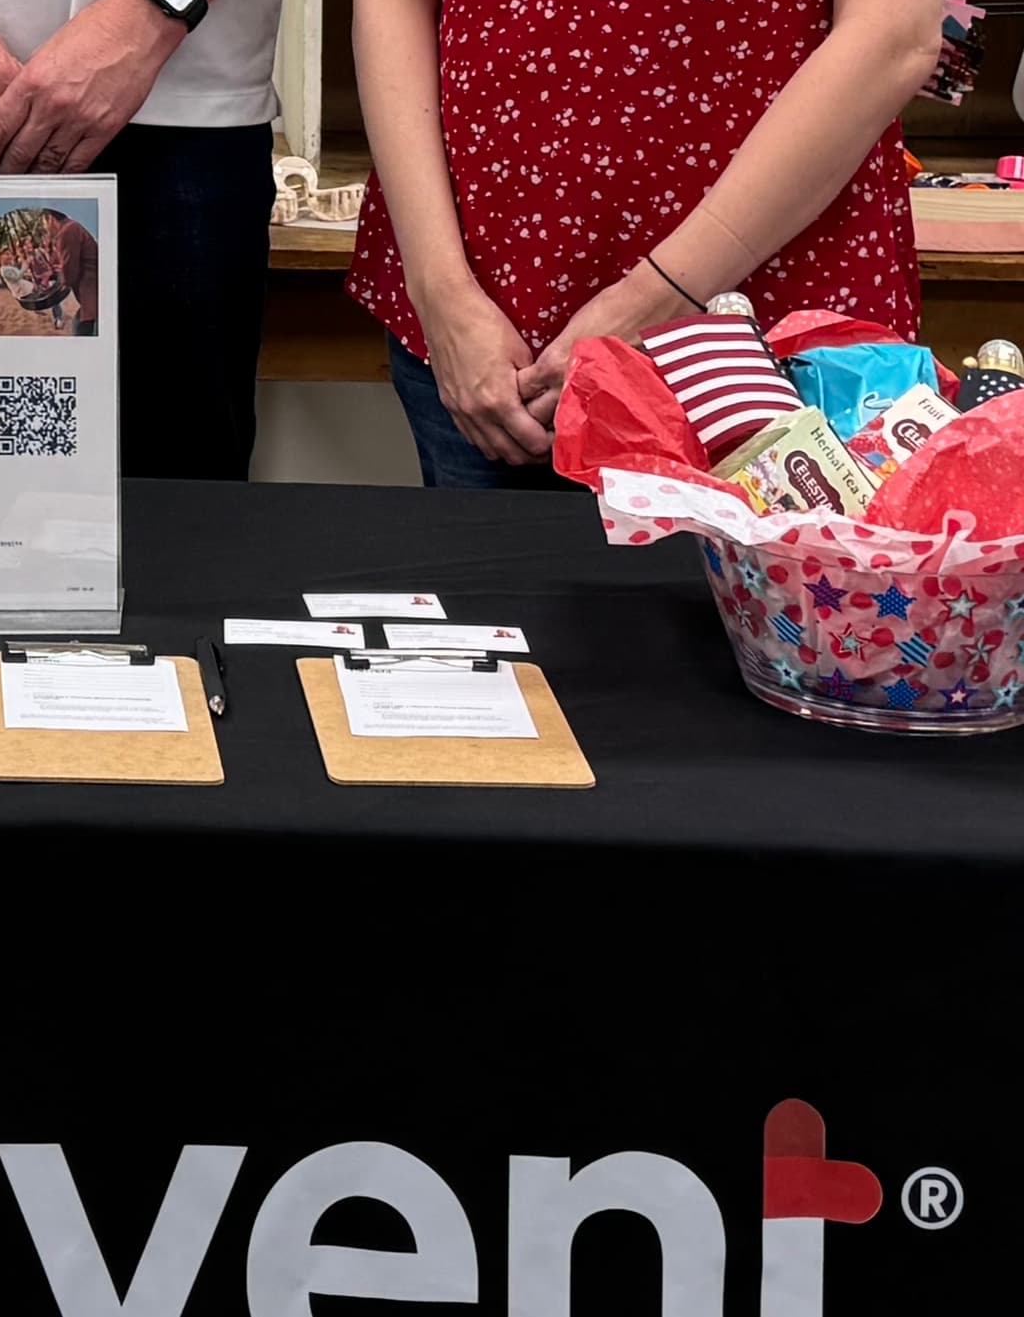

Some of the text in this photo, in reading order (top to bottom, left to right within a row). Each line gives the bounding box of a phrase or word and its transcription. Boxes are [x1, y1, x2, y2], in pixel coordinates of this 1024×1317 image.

[918, 398, 945, 420] Fruit
[810, 427, 845, 472] Herbal
[842, 469, 860, 495] Tea
